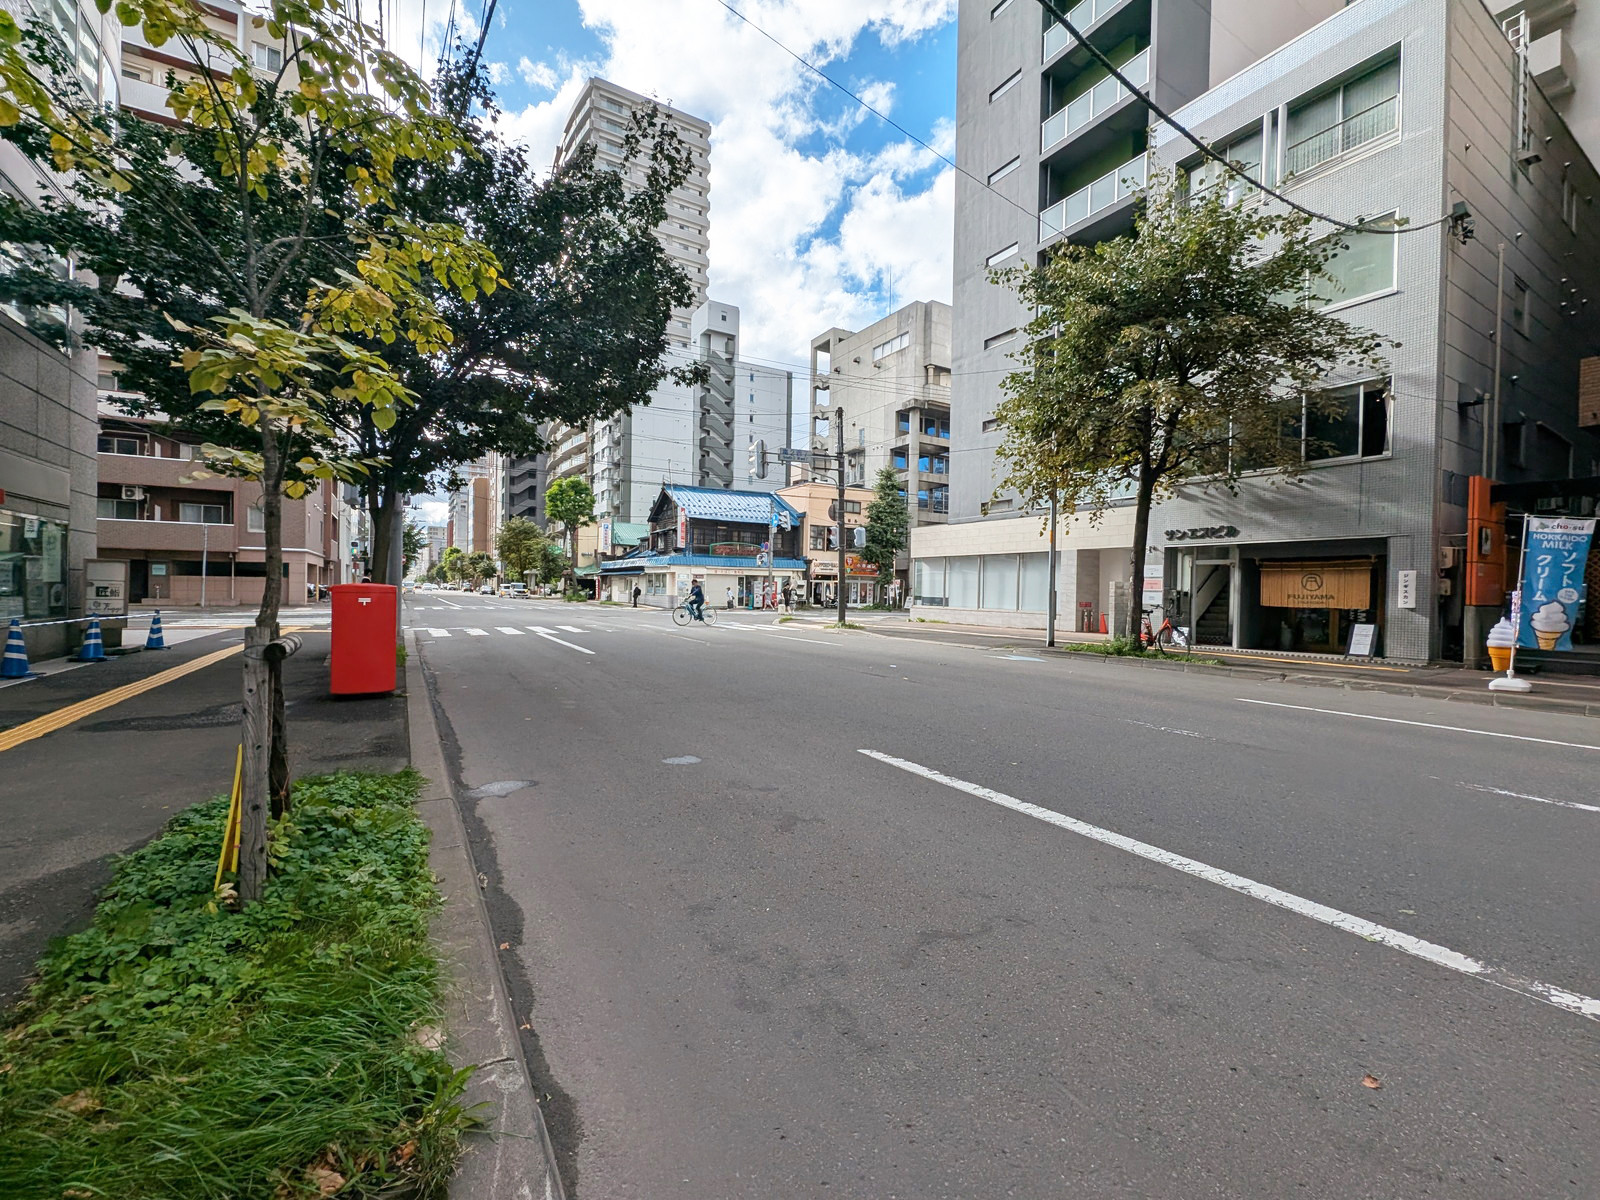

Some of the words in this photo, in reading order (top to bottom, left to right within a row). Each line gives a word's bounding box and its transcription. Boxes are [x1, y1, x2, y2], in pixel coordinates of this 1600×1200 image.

[1164, 526, 1241, 541] サンエスビル
[1533, 533, 1588, 542] HOKKAIDO
[1542, 541, 1573, 550] MILK
[1562, 551, 1577, 587] ソフト
[1532, 554, 1552, 601] クリーム
